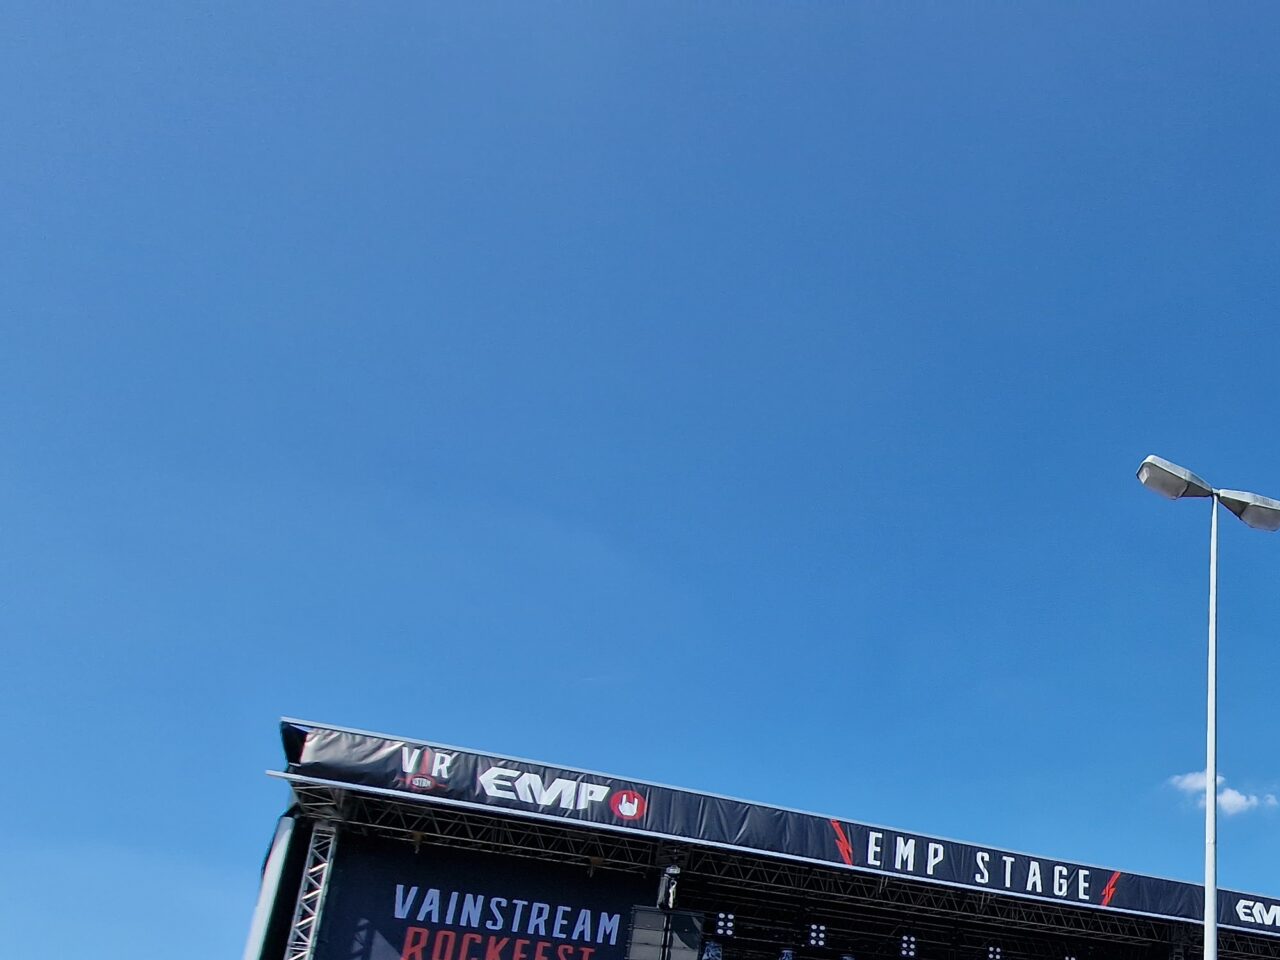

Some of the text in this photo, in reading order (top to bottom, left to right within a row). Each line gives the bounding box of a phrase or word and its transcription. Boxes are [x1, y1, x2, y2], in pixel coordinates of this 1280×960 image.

[478, 765, 611, 811] EMP
[867, 831, 1091, 900] EMP STAGE
[394, 883, 621, 946] VAINSTREAM
